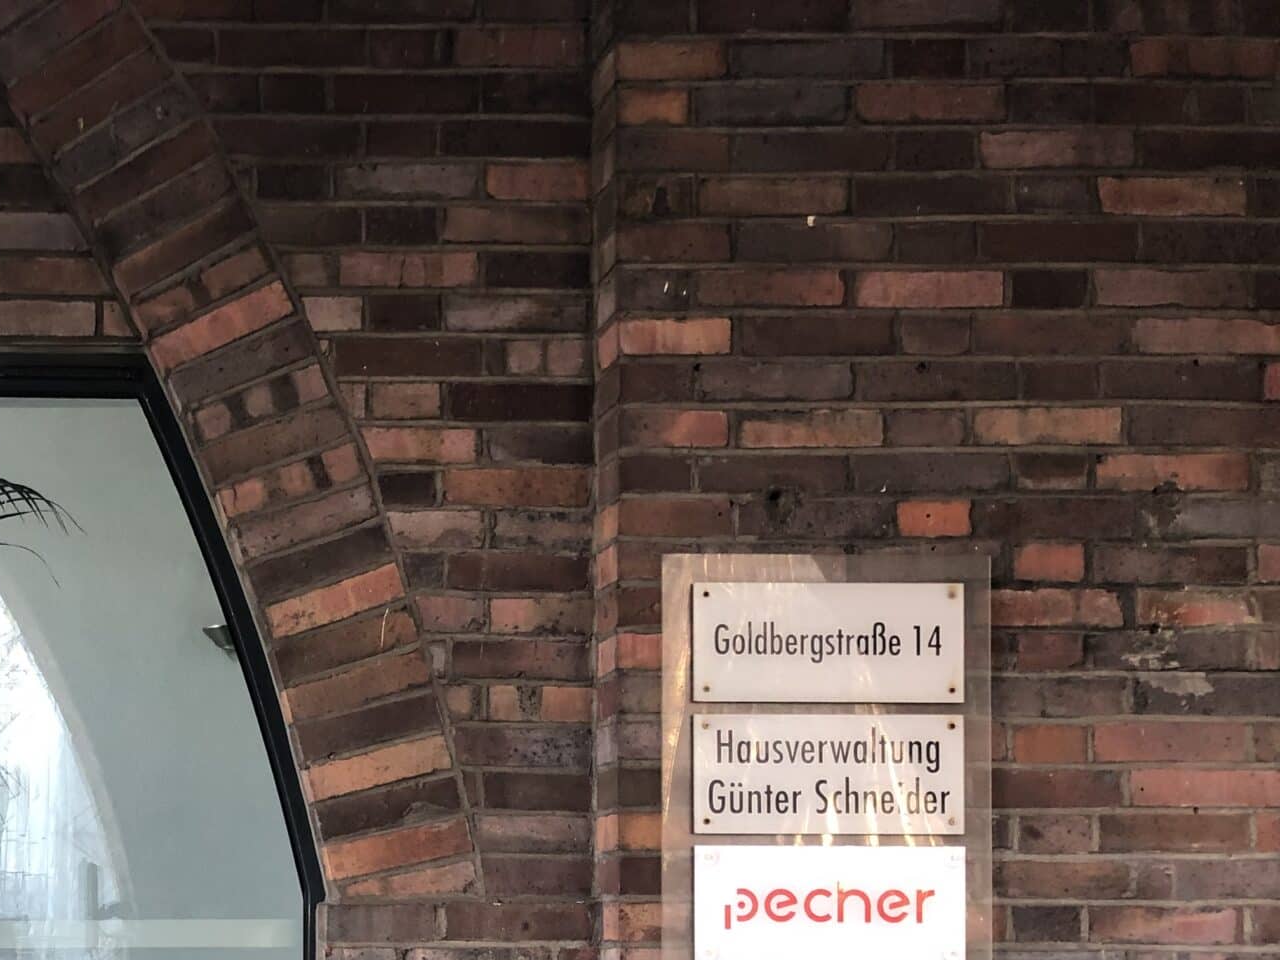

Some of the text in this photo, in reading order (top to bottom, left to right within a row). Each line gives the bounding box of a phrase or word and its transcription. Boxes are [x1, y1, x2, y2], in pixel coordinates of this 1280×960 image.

[714, 621, 943, 663] Goldbergstraße 14
[716, 727, 940, 773] Hausverwaltung
[708, 778, 802, 814] Günter
[724, 880, 935, 930] pecher
